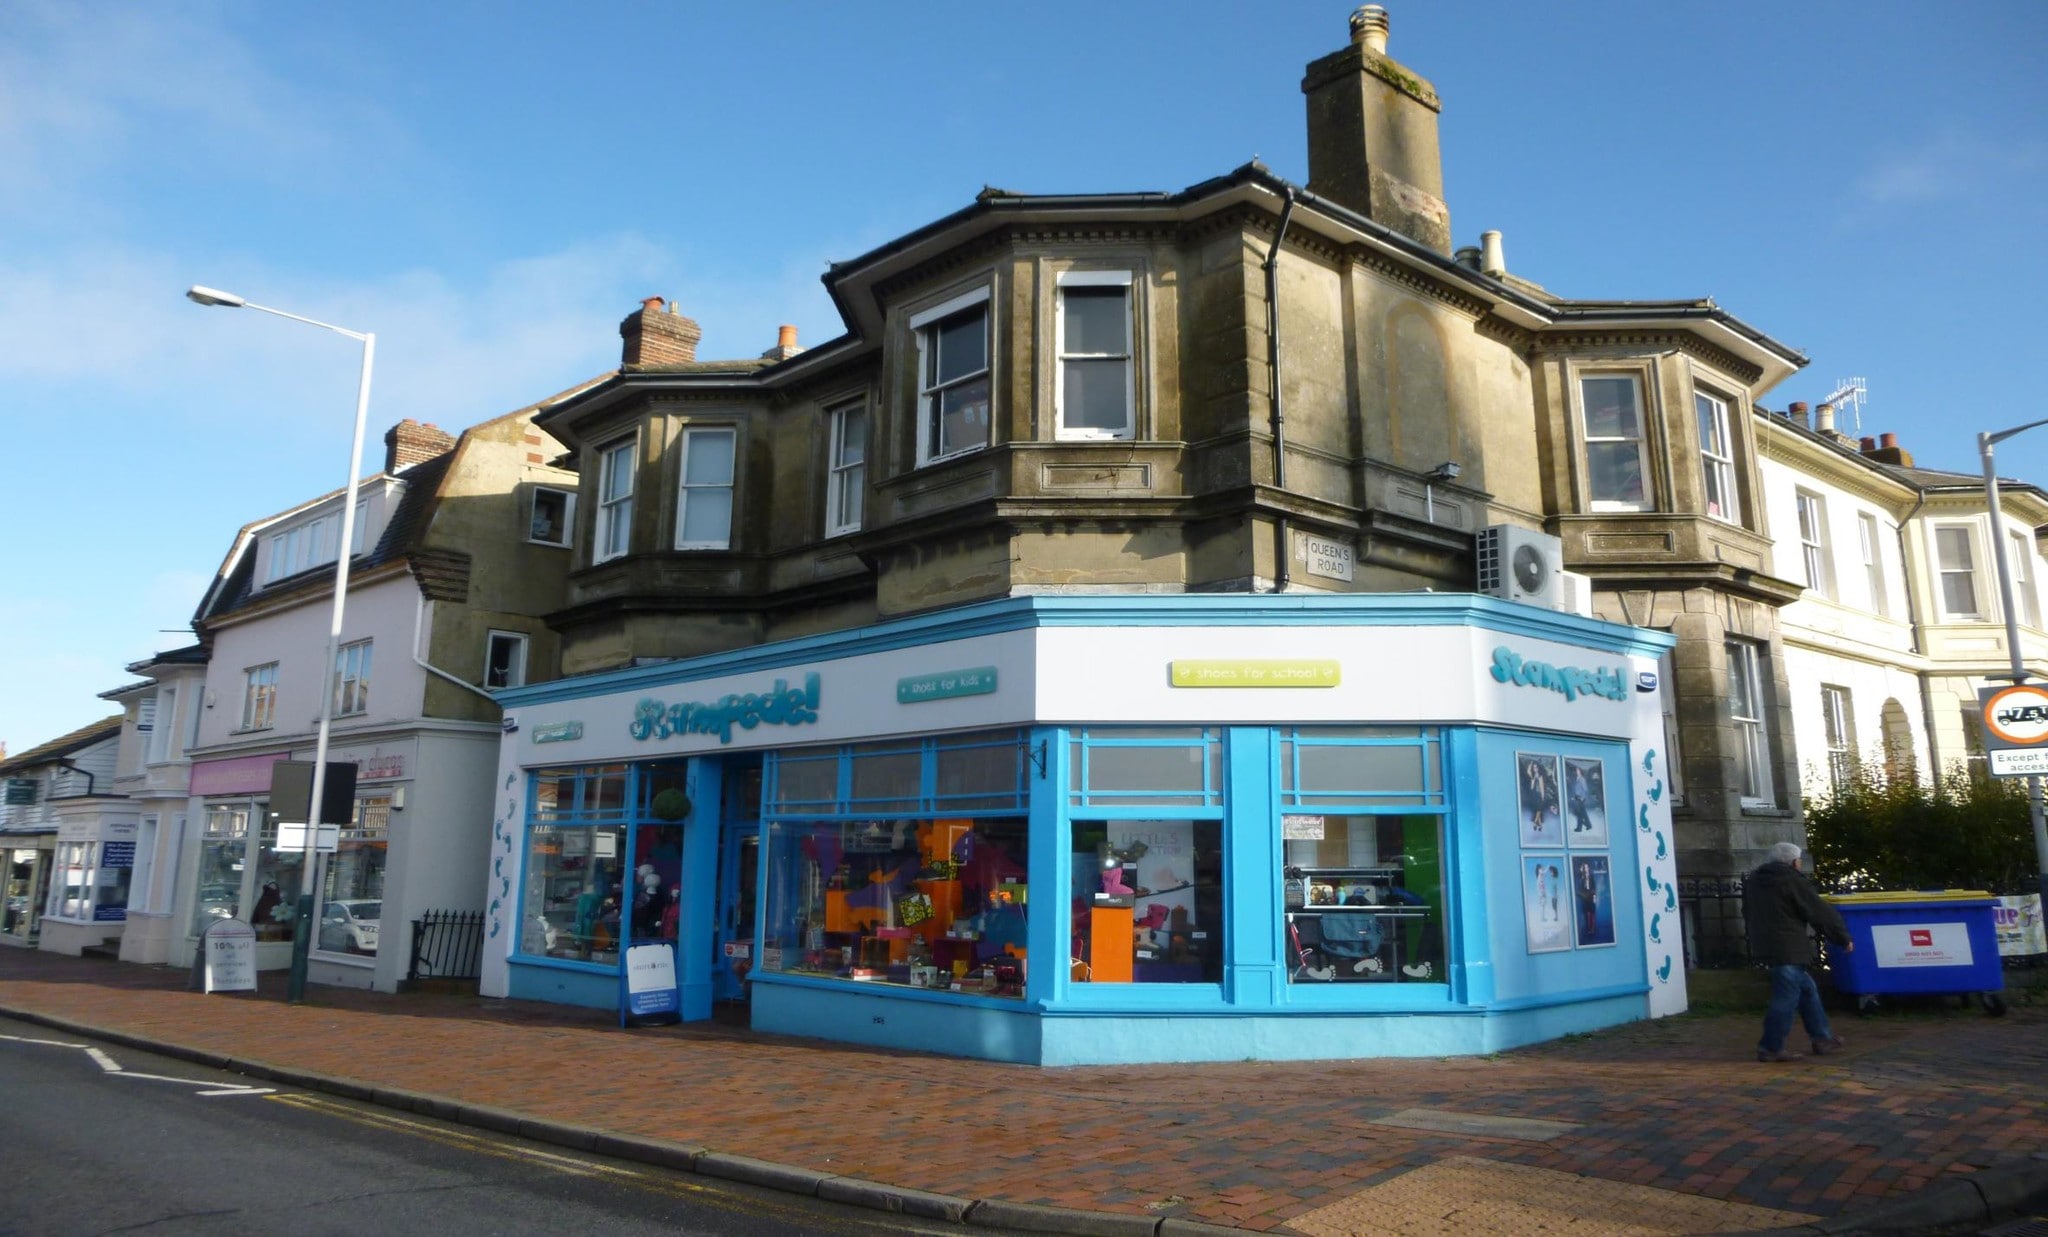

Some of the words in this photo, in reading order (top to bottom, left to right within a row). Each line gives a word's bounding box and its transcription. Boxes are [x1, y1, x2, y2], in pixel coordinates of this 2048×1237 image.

[1317, 558, 1344, 574] ROAD
[1197, 667, 1237, 679] shoes
[1244, 667, 1266, 679] for
[1271, 667, 1317, 679] school
[941, 679, 956, 690] for
[1997, 753, 2040, 763] Except
